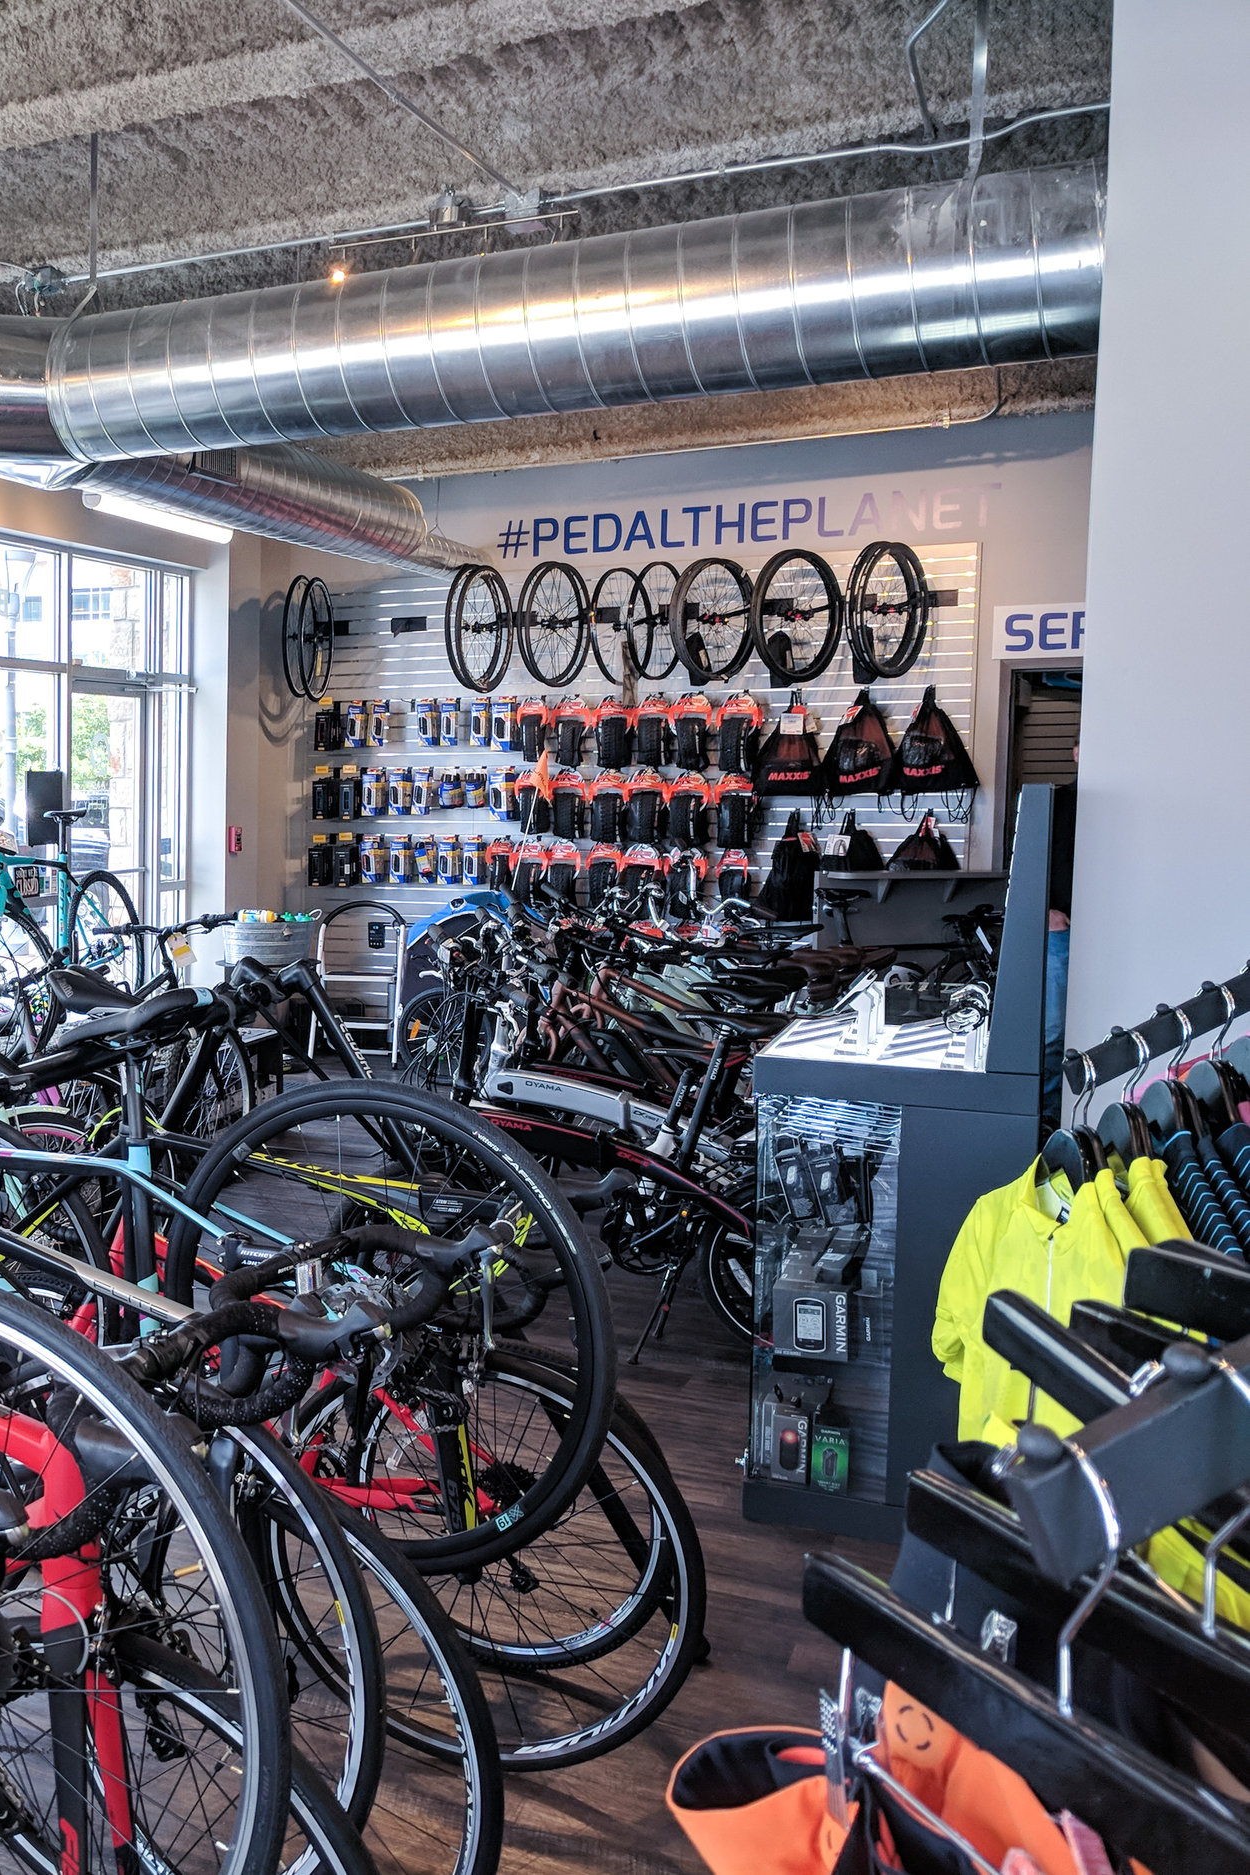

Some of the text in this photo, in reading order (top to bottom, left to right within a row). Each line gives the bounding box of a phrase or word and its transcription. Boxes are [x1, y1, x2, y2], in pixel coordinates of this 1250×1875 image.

[496, 482, 1003, 561] #PEDALTHEPLANET
[767, 770, 811, 781] MAXXIS
[838, 766, 882, 783] MAXXIS
[902, 764, 945, 777] MAXXIS
[501, 1153, 553, 1210] ZAFFIRO
[240, 1250, 274, 1259] RITCHEY
[834, 1293, 848, 1354] GARMIN
[814, 1434, 846, 1446] VARIA
